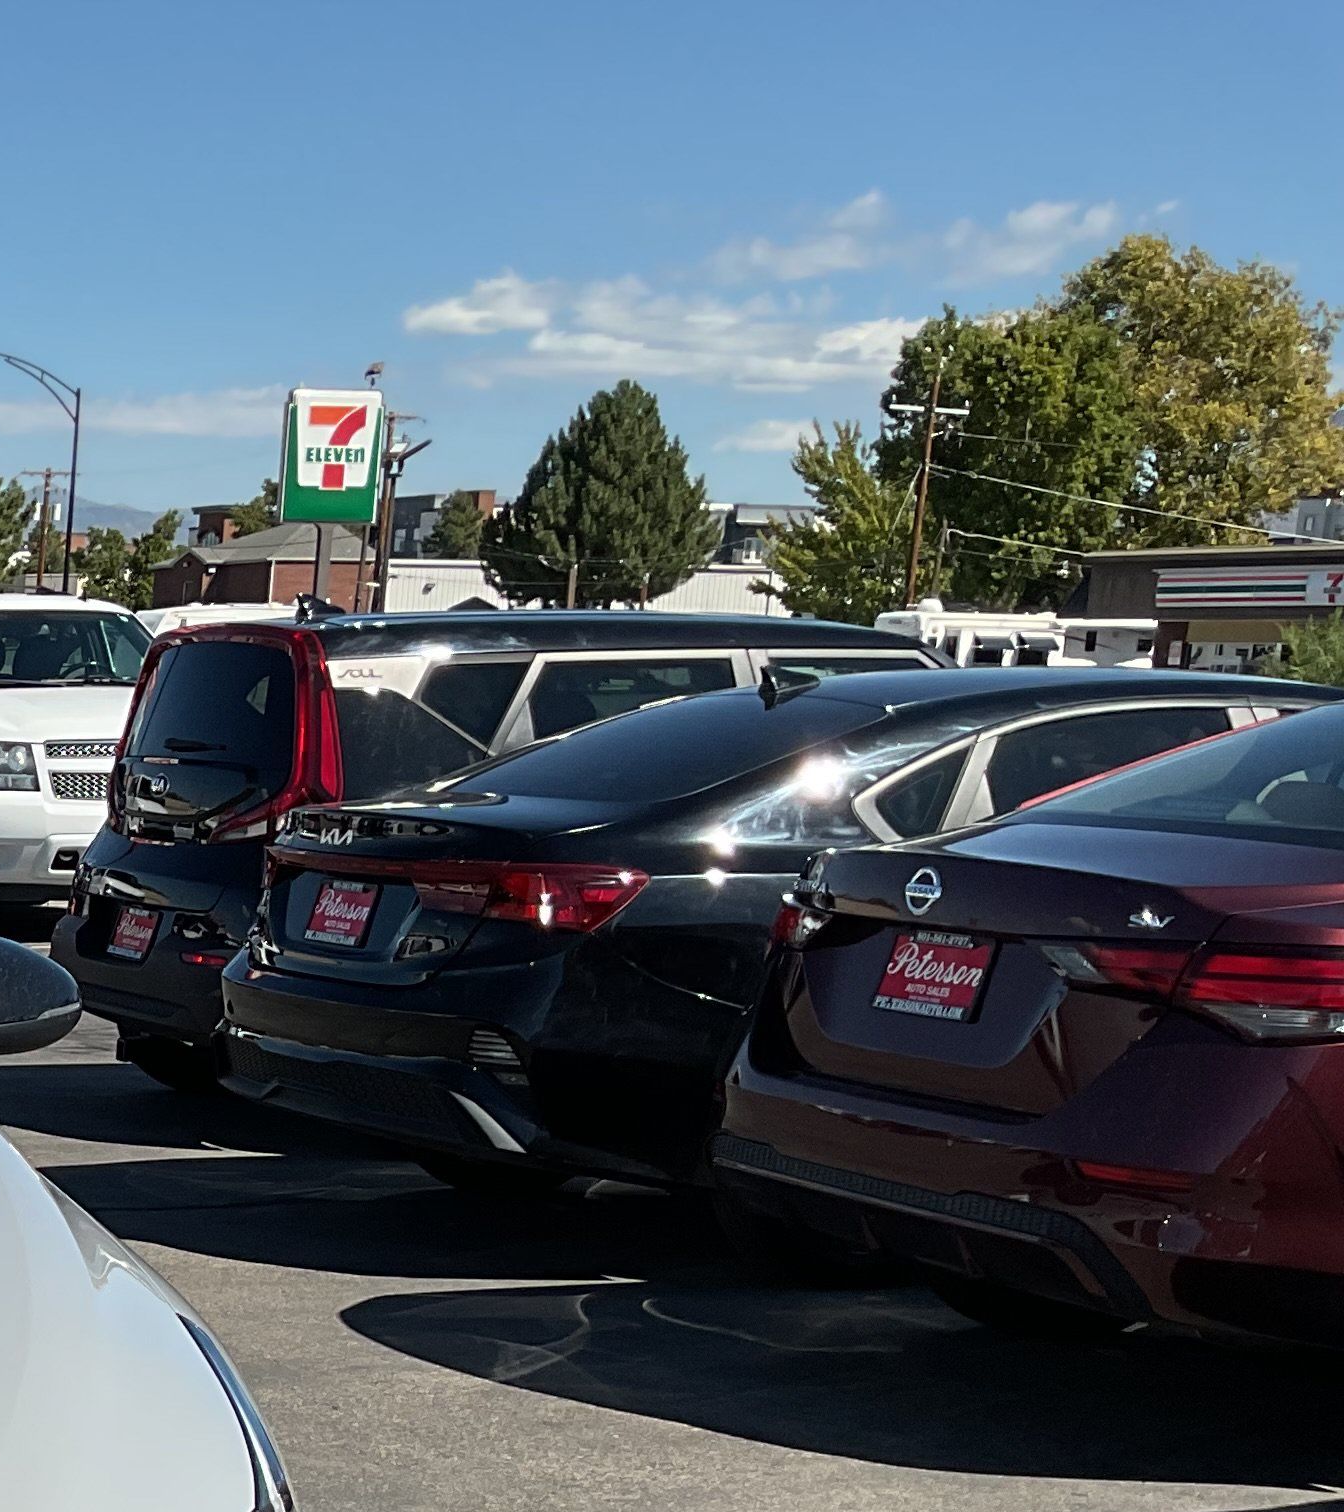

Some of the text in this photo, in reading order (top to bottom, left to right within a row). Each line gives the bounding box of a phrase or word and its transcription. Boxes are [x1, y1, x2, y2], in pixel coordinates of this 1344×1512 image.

[308, 405, 368, 489] 7
[315, 889, 370, 922] Peterson
[886, 942, 984, 988] Peterson
[905, 982, 951, 997] AUTO SALES
